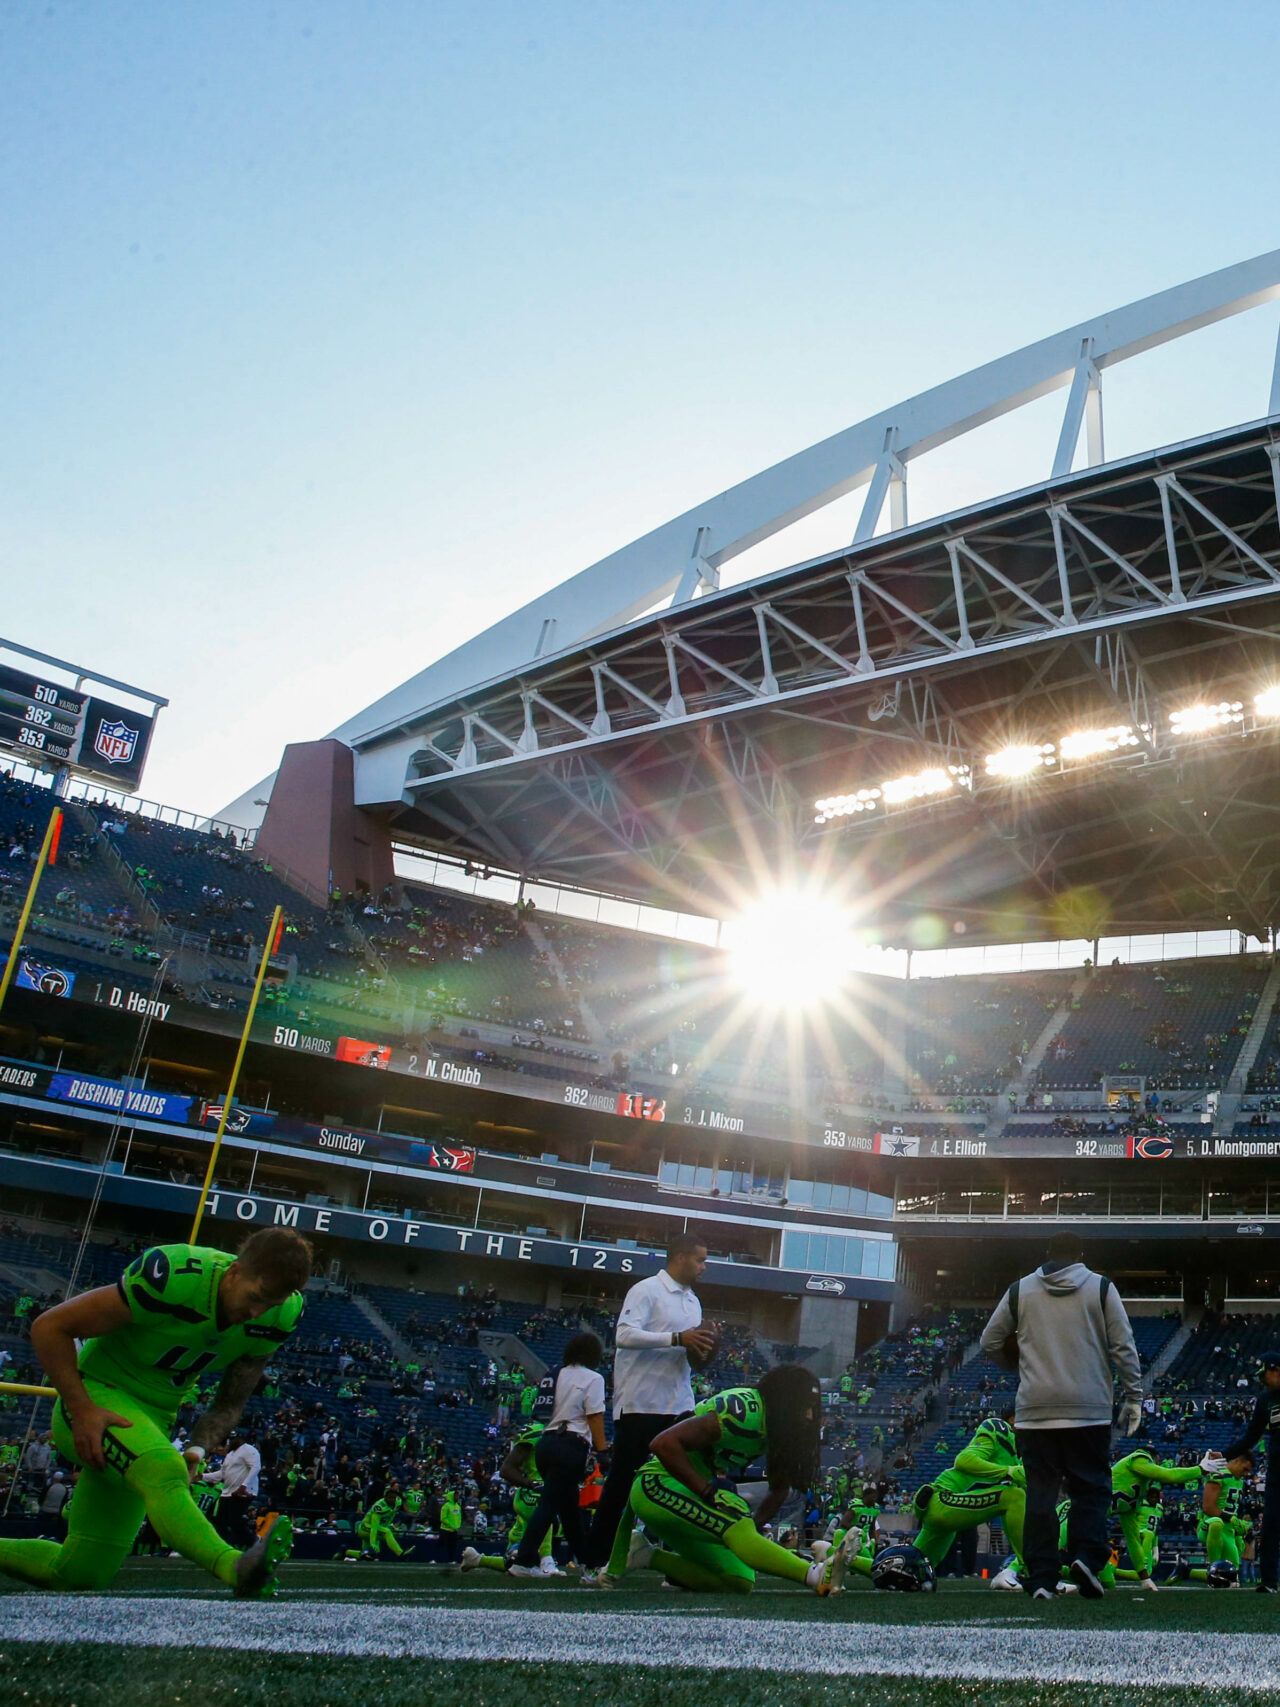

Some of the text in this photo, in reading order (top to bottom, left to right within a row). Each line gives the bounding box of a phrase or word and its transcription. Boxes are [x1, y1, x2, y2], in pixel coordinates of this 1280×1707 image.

[34, 684, 79, 713] 510 YARDS
[25, 705, 74, 735] 362 YARDS
[19, 727, 68, 757] 353 YARDS
[100, 735, 128, 758] NFL
[94, 983, 170, 1021] 1. D. Henry
[274, 1025, 331, 1054] 510 YARDS
[408, 1055, 481, 1086] 2. N. Chubb
[68, 1080, 167, 1115] RUSHING YARDS
[564, 1086, 615, 1111] 362 YARDS
[683, 1107, 744, 1132] 3. J. Mixon
[319, 1128, 365, 1155] Sunday
[824, 1130, 872, 1151] 353 YARDS
[930, 1140, 987, 1156] 4. E. Elliott
[1075, 1140, 1124, 1156] 342 YARDS
[1187, 1141, 1197, 1156] 5.
[1201, 1140, 1212, 1156] D.
[368, 1219, 420, 1244] OF
[457, 1231, 534, 1260] THE
[569, 1248, 633, 1272] 12s
